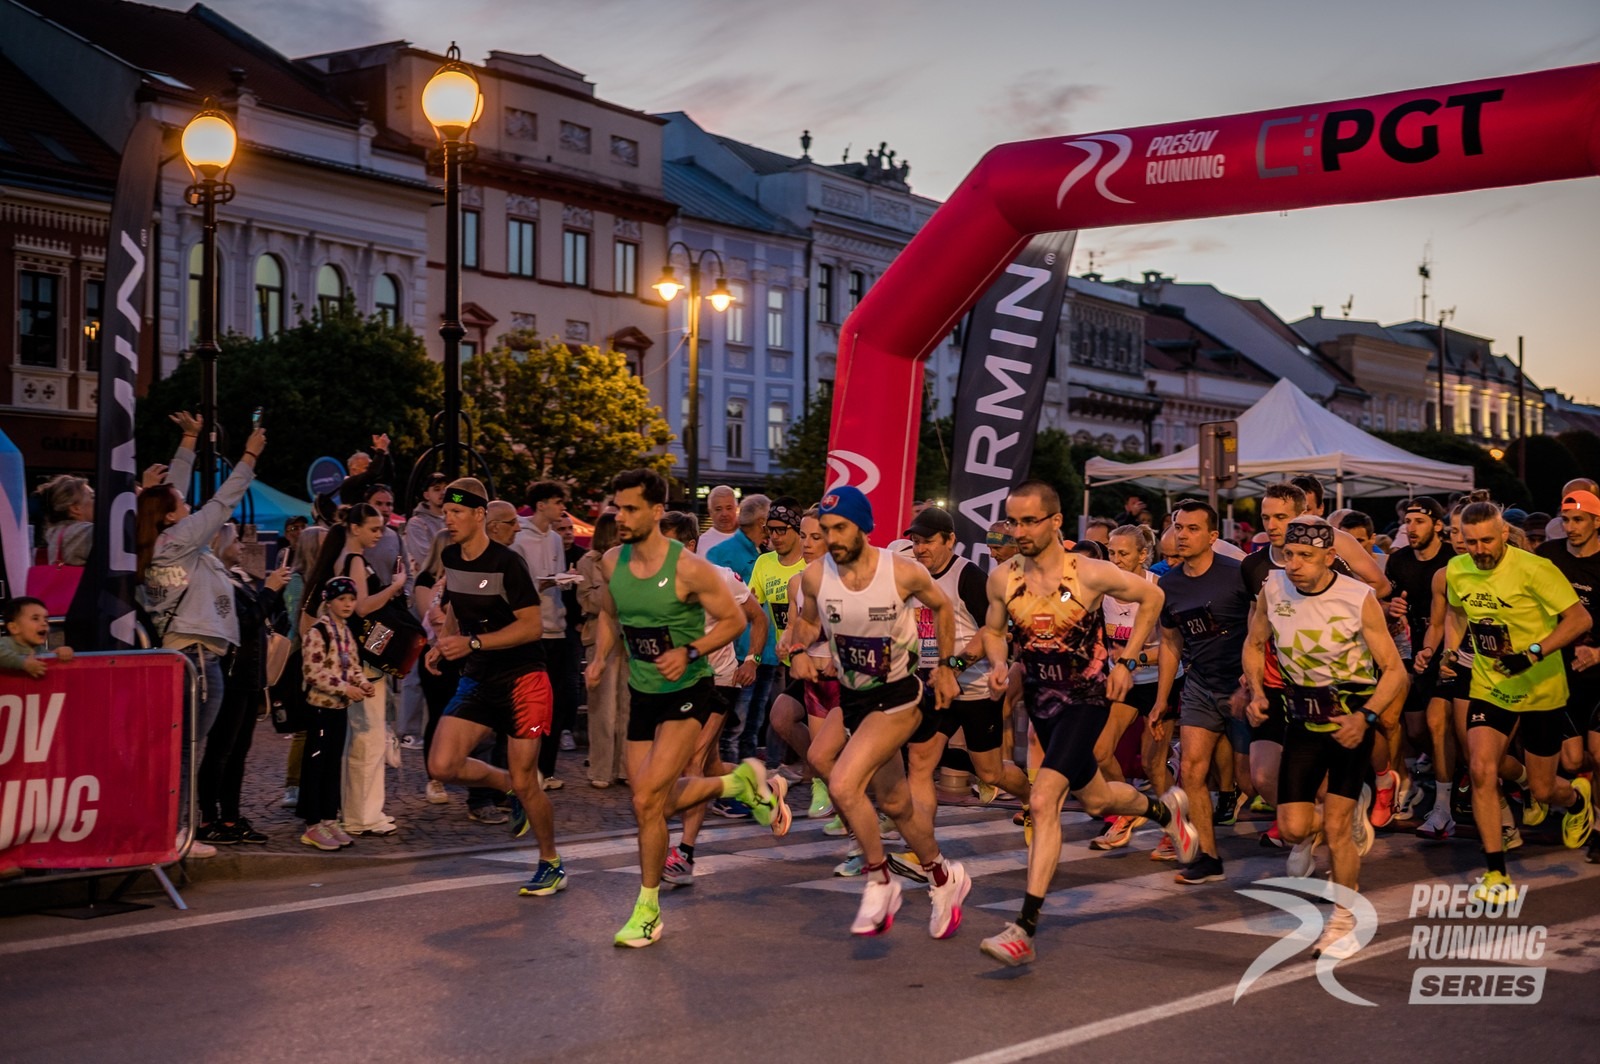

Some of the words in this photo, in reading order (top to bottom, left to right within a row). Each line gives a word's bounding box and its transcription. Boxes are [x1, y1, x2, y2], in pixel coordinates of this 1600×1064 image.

[1145, 129, 1219, 158] PREŠOV
[1146, 154, 1225, 185] RUNNING
[1187, 617, 1207, 635] 231
[1479, 634, 1498, 651] 210
[848, 646, 876, 668] 354
[1037, 663, 1063, 681] 341
[1304, 697, 1321, 715] 71
